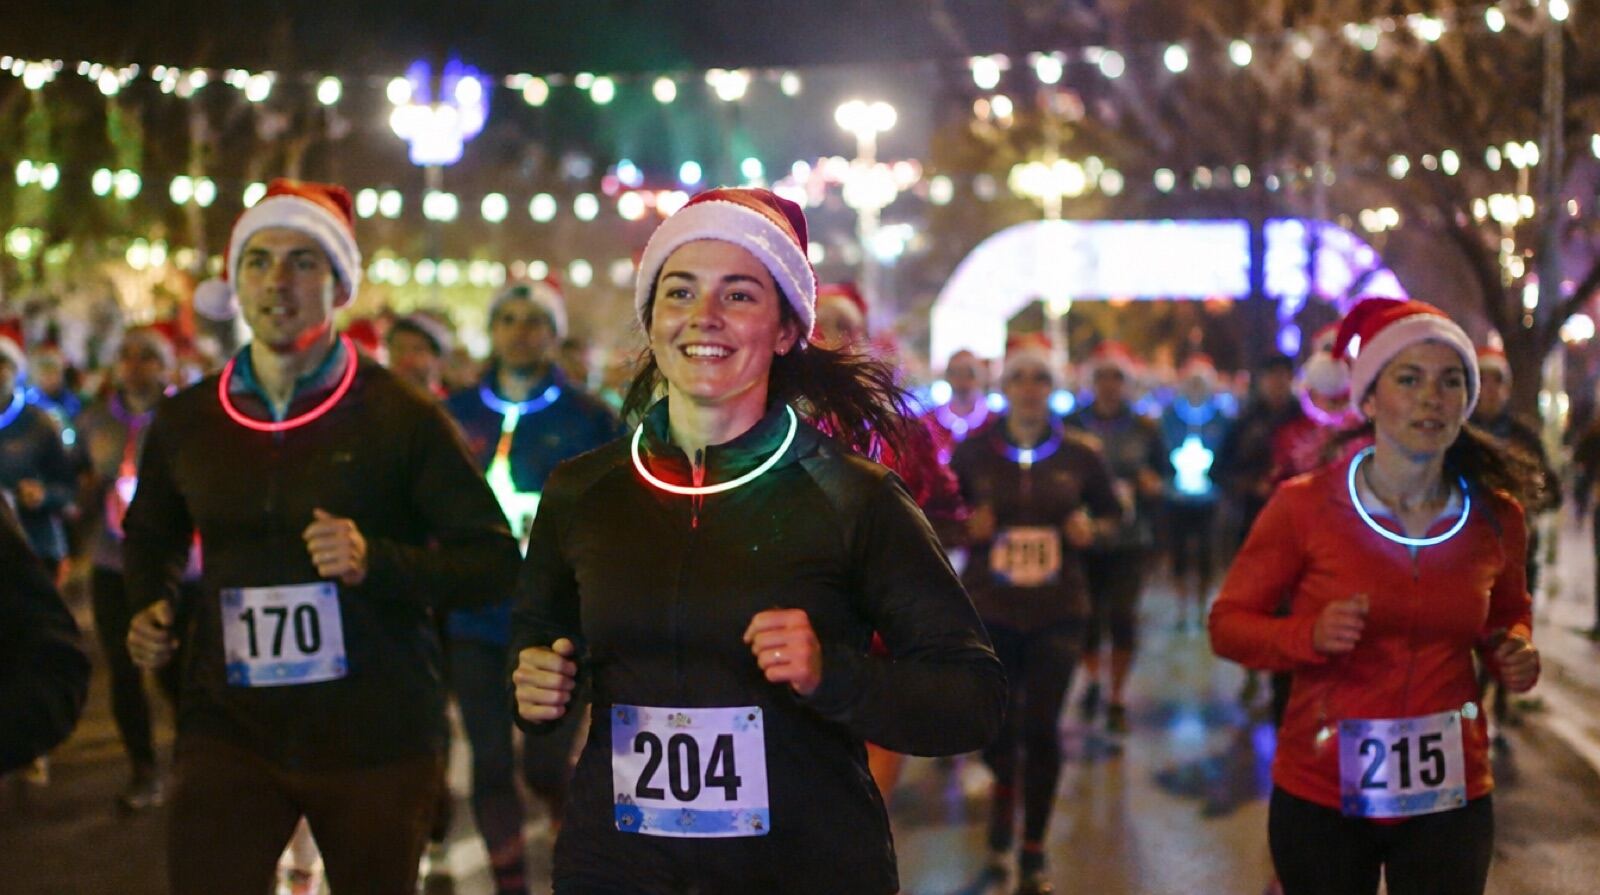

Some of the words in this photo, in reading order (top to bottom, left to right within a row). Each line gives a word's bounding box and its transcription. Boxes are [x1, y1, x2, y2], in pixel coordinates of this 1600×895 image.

[239, 604, 322, 657] 170
[634, 731, 742, 801] 204
[1359, 732, 1446, 789] 215
